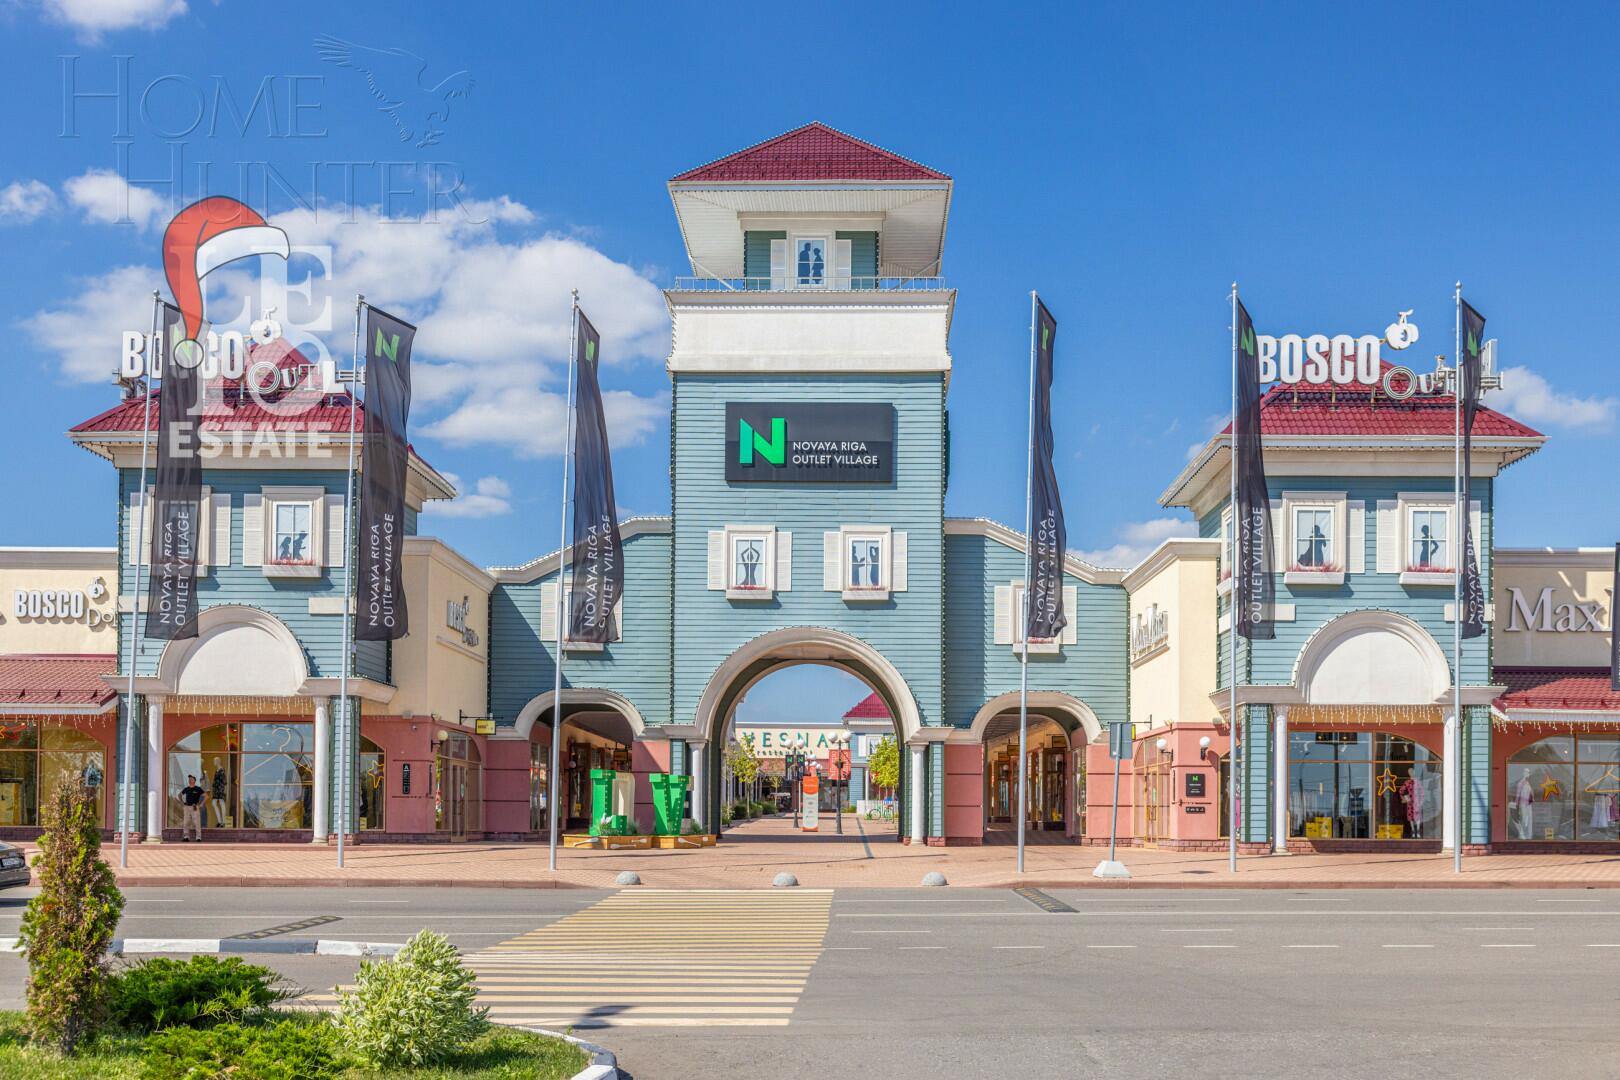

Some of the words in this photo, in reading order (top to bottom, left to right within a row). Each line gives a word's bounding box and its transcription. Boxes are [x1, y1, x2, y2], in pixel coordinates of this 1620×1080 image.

[375, 327, 400, 362] N
[1257, 334, 1380, 384] BOSCO
[739, 417, 785, 465] N
[792, 455, 832, 465] OUTLET
[834, 455, 878, 465] VILLAGE
[793, 441, 838, 451] NOVAYA
[841, 441, 867, 451] RIGA
[164, 521, 173, 557] RIGA
[178, 511, 190, 569] VILLAGE
[371, 524, 380, 559] RIGA
[384, 513, 395, 571] VILLAGE
[588, 525, 598, 560] RIGA
[602, 514, 614, 572] VILLAGE
[1038, 519, 1048, 555] RIGA
[1252, 506, 1263, 567] VILLAGE
[15, 590, 84, 619] BOSCO
[160, 562, 173, 624] NOVAYA
[175, 576, 189, 626] OUTLET
[369, 564, 380, 626] NOVAYA
[383, 575, 395, 627] OUTLET
[584, 564, 598, 627] NOVAYA
[1036, 560, 1045, 622] NOVAYA
[1251, 574, 1263, 624] OUTLET
[1467, 562, 1476, 624] NOVAYA
[1504, 586, 1613, 634] Max
